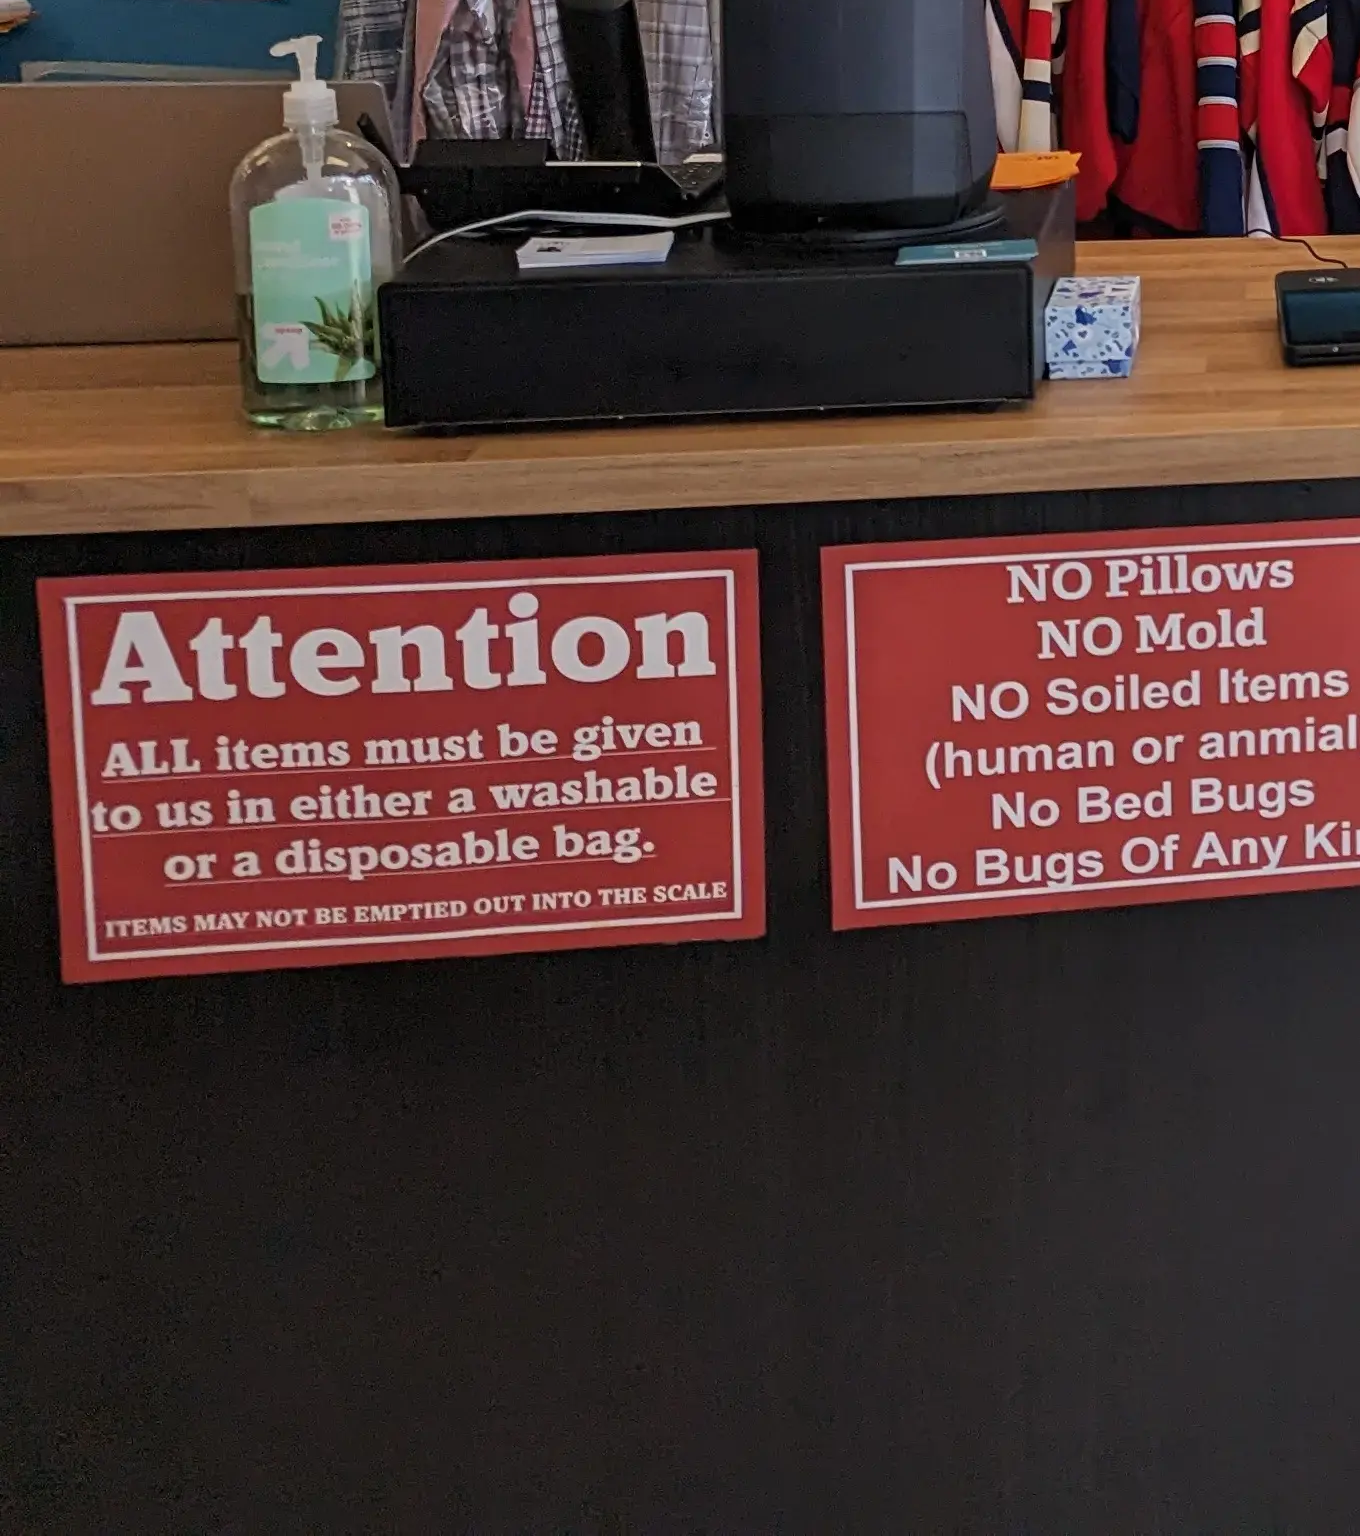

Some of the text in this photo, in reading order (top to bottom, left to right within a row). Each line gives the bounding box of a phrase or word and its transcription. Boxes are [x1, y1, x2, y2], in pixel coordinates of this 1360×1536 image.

[1006, 555, 1296, 604] NO Pillows
[90, 591, 717, 706] Attention
[1036, 607, 1268, 660] NO Mold
[950, 667, 1350, 723] NO Soiled Items
[101, 715, 703, 777] ALL items must be given
[924, 734, 1116, 790] (human
[1131, 732, 1184, 766] or
[92, 766, 718, 834] to us in either a washable
[991, 774, 1316, 831] No Bed Bugs
[164, 823, 657, 883] or a disposable bag.
[887, 855, 959, 895] No
[975, 846, 1105, 890] Bugs
[1121, 835, 1179, 875] Of
[1192, 831, 1289, 874] Any
[104, 881, 729, 939] ITEMS MAY NOT BE EMPTIED OUT INTO THE SCALE
